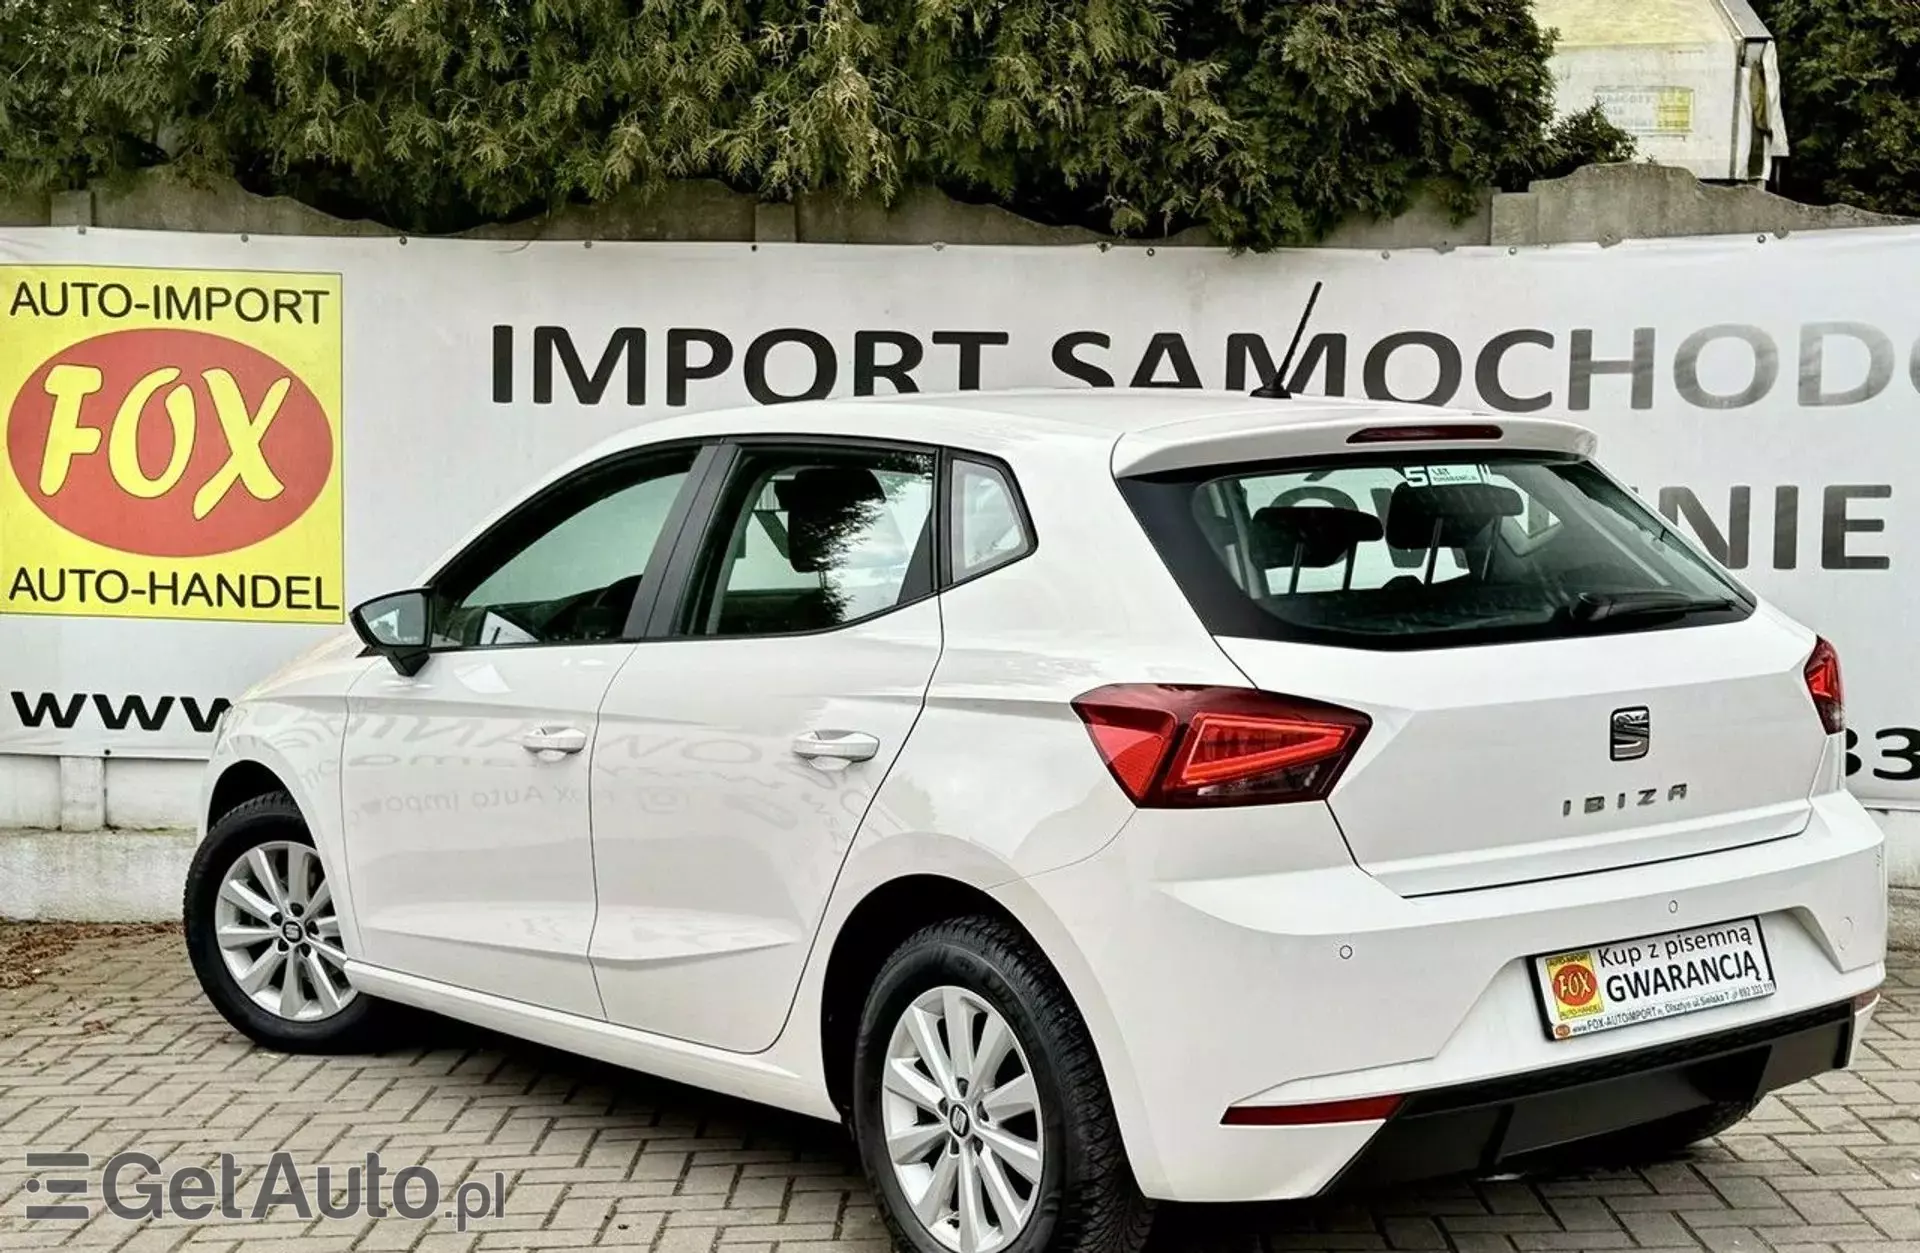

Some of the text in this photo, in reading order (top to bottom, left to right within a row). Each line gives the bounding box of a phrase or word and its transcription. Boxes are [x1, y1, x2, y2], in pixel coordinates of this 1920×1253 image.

[9, 281, 329, 325] AUTO-IMPORT
[493, 321, 1920, 412] IMPORT SAMOCHOD
[38, 363, 292, 521] FOX
[8, 567, 340, 611] AUTO-HANDEL
[1562, 783, 1687, 817] IBIZA
[1598, 926, 1753, 968] Kup z pisemną
[1558, 972, 1592, 999] FOX
[1606, 950, 1761, 1003] GWARANCJĄ
